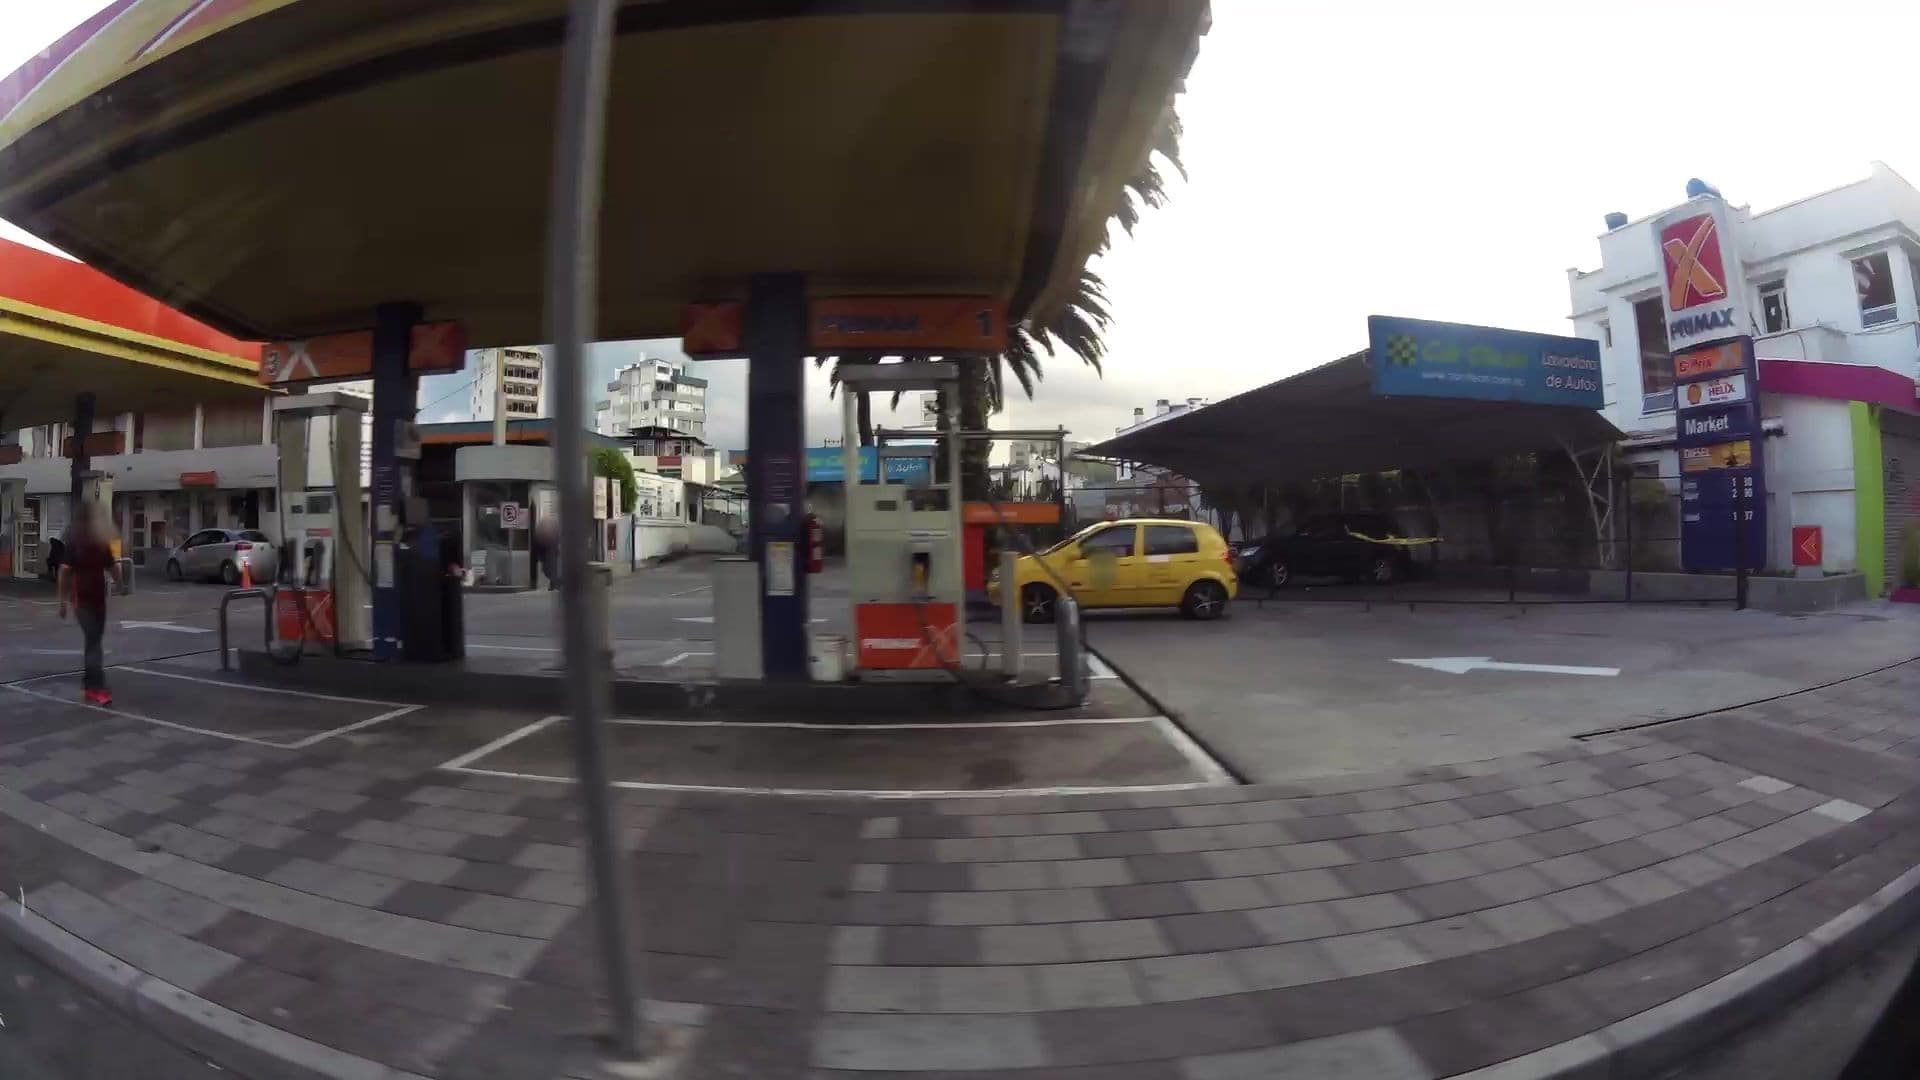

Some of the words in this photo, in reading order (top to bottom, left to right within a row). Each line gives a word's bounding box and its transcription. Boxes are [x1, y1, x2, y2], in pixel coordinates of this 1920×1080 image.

[976, 310, 993, 337] 1
[1670, 307, 1734, 340] PRIMAX
[1545, 374, 1563, 388] de
[1564, 375, 1598, 392] Autos
[1708, 383, 1736, 397] HELIX
[1685, 414, 1729, 435] Market
